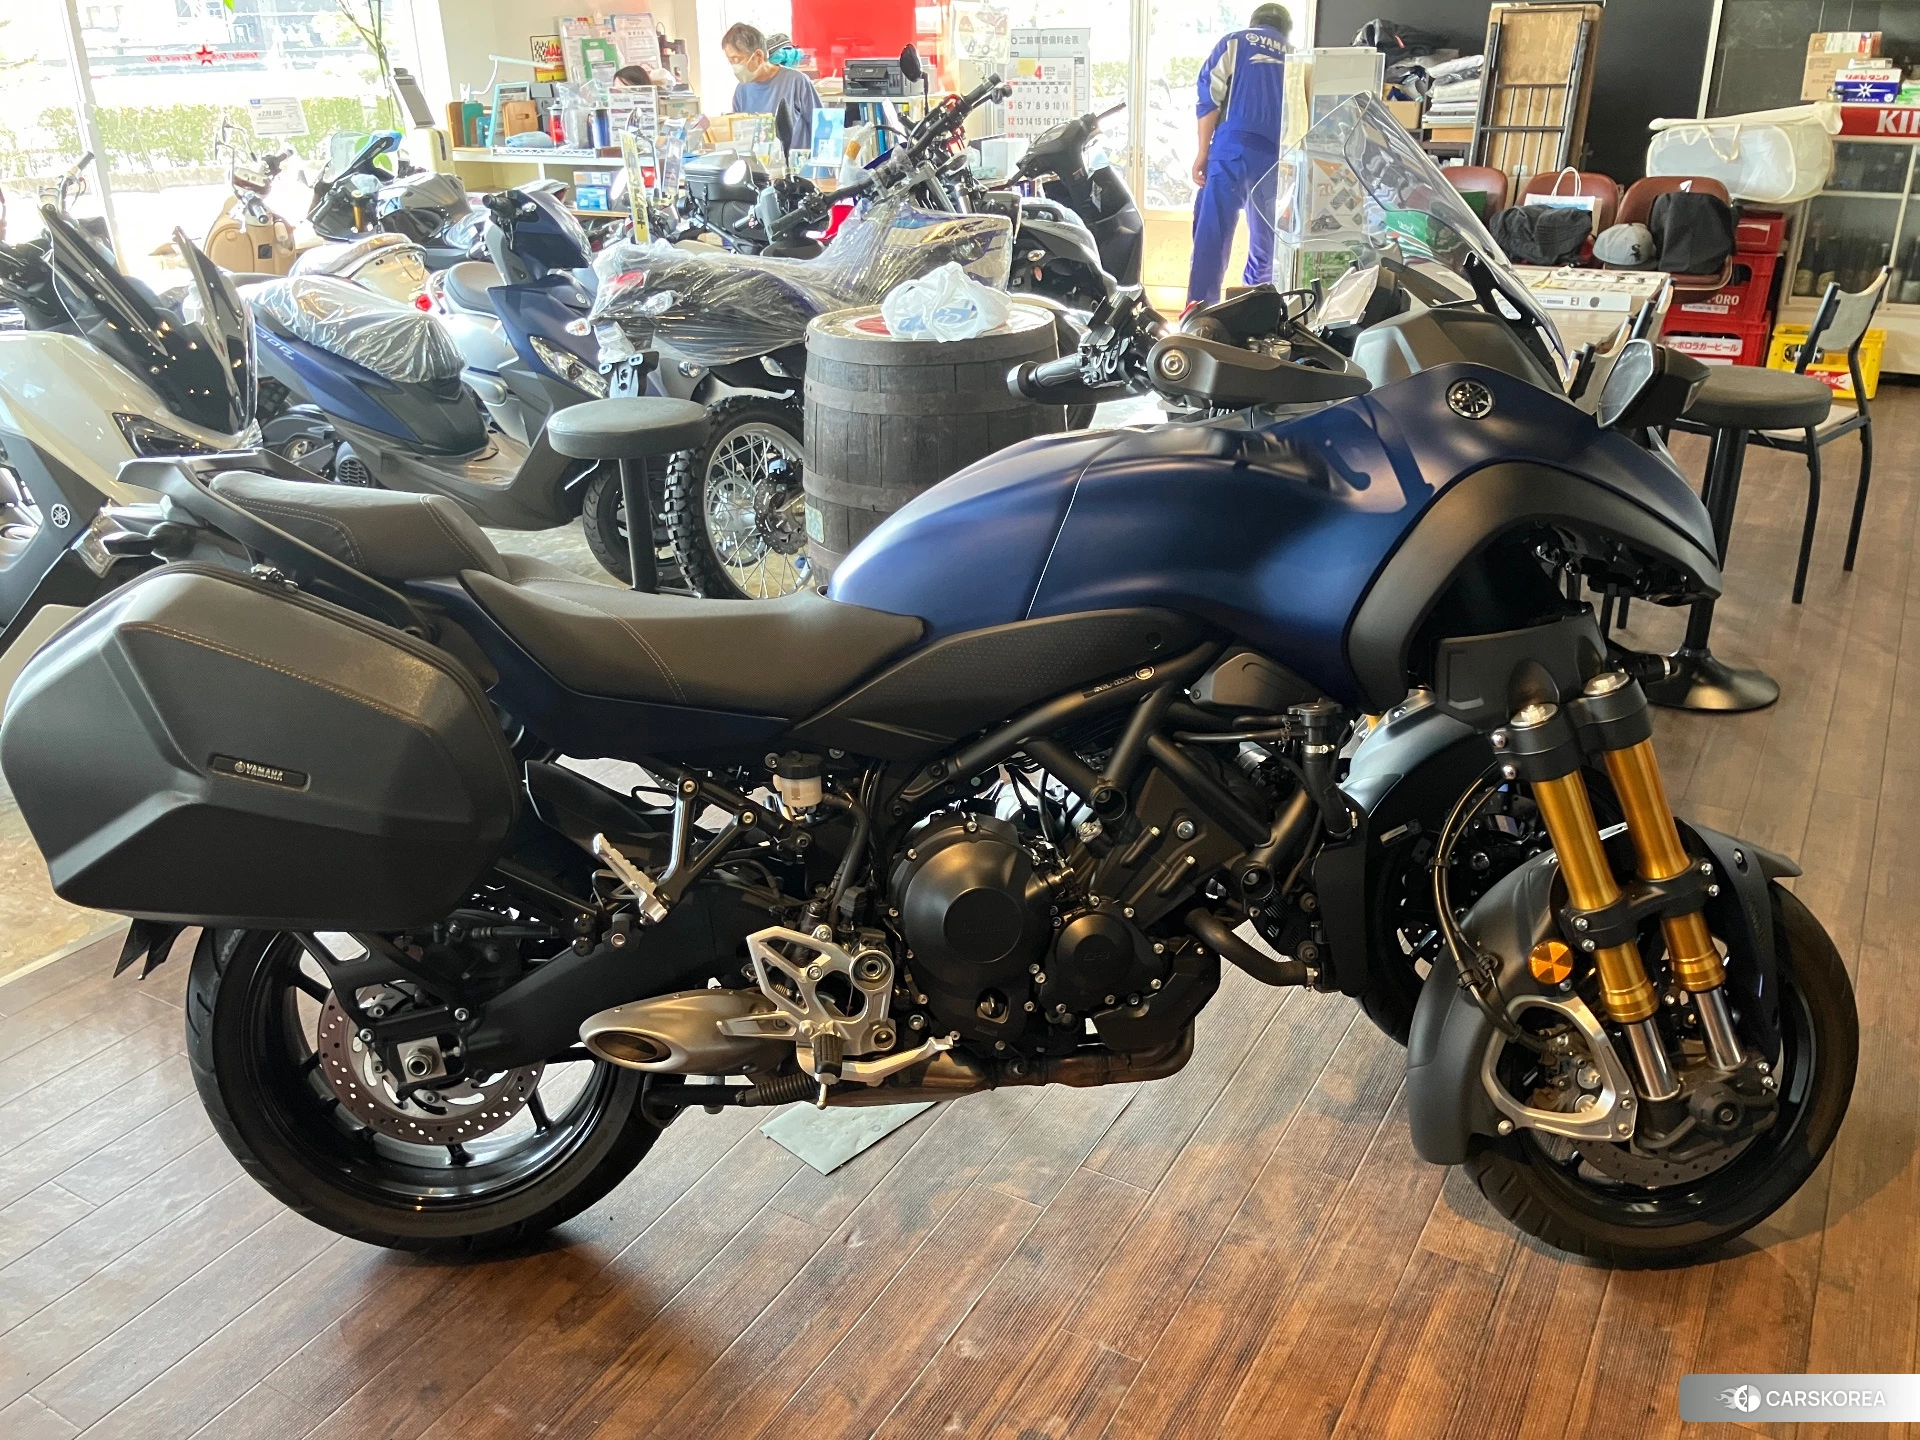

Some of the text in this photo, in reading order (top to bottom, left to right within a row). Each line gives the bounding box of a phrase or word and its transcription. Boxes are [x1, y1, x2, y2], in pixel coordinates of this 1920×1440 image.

[1259, 35, 1288, 54] YAMA
[1034, 65, 1043, 80] 4
[1045, 86, 1050, 94] 2
[1054, 86, 1059, 94] 3
[1063, 86, 1068, 94] 4
[1008, 101, 1069, 110] 5 6 7 8 9 10 11
[1008, 117, 1015, 126] 12
[1016, 117, 1024, 126] 13
[1025, 117, 1033, 126] 14
[1034, 117, 1042, 126] 15
[1043, 117, 1051, 126] 16
[1052, 117, 1060, 126] 17
[1663, 340, 1739, 352] サッポロラガービール
[246, 763, 283, 781] YAMAHA
